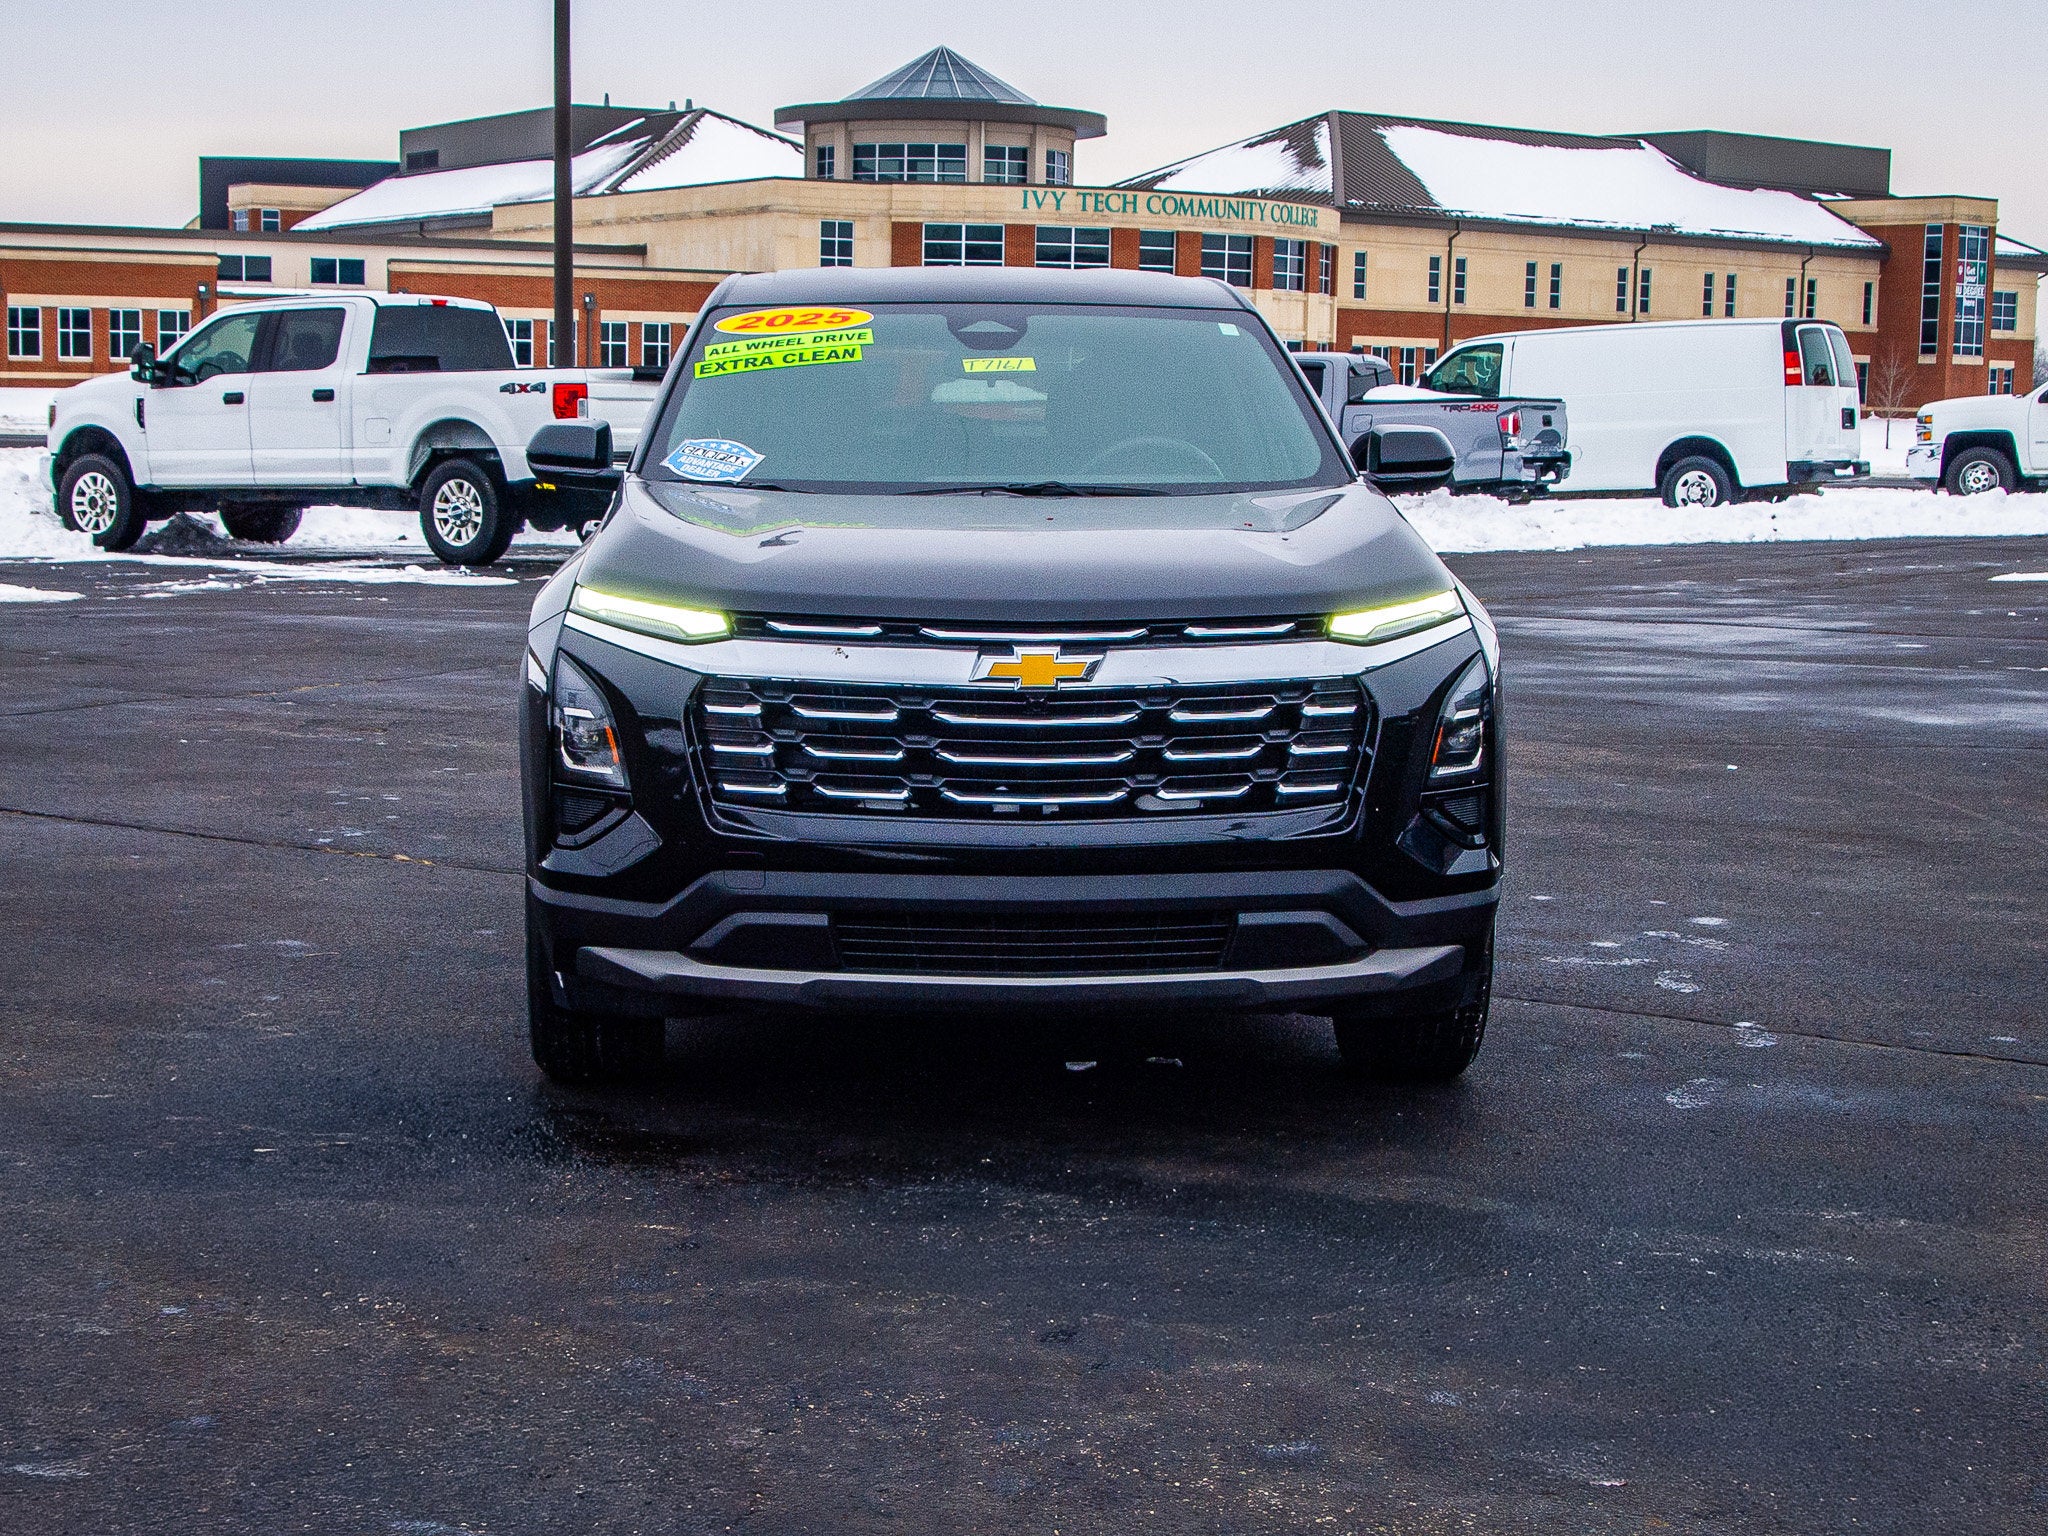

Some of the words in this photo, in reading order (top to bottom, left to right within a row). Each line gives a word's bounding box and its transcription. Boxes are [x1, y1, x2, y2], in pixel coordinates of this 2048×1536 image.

[1022, 190, 1067, 210] IVY
[1077, 192, 1138, 214] TECH
[1146, 194, 1266, 221] COMMUNITY
[1270, 203, 1319, 228] COLLEGE
[733, 311, 855, 330] 2025
[709, 346, 740, 356] ALL
[746, 337, 806, 351] WHEEL
[812, 332, 869, 345] DRIVE
[699, 355, 774, 375] EXTRA
[782, 347, 857, 364] CLEAN
[678, 455, 737, 473] ADVANTAGE
[680, 463, 721, 478] DEALER
